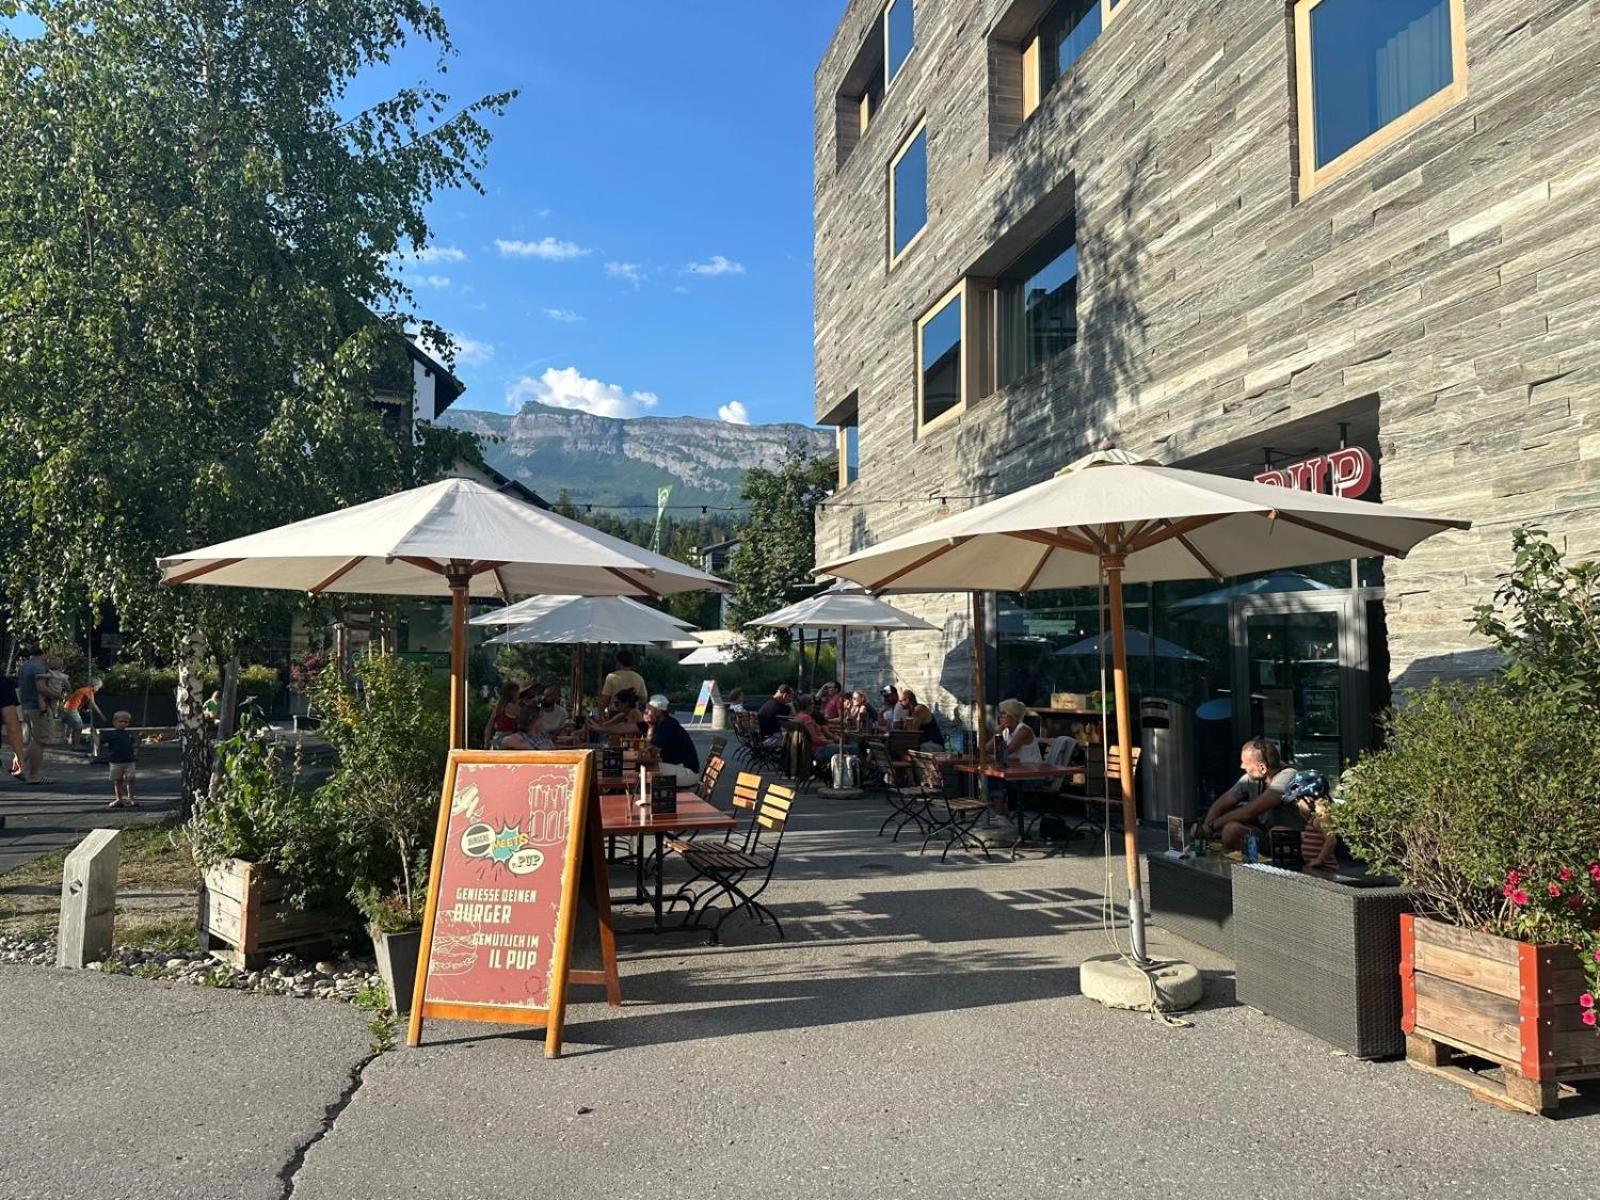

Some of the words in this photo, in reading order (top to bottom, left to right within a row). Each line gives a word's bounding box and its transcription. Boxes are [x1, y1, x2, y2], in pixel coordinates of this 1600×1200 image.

[492, 833, 529, 848] MEETS
[518, 855, 541, 867] PUP
[456, 888, 500, 901] GENIESSE
[502, 889, 537, 903] DEINEN
[454, 903, 512, 924] BURGER
[472, 932, 525, 947] GEMÜTLICH
[527, 935, 540, 948] IM
[489, 949, 501, 968] IL
[506, 950, 537, 970] PUP
